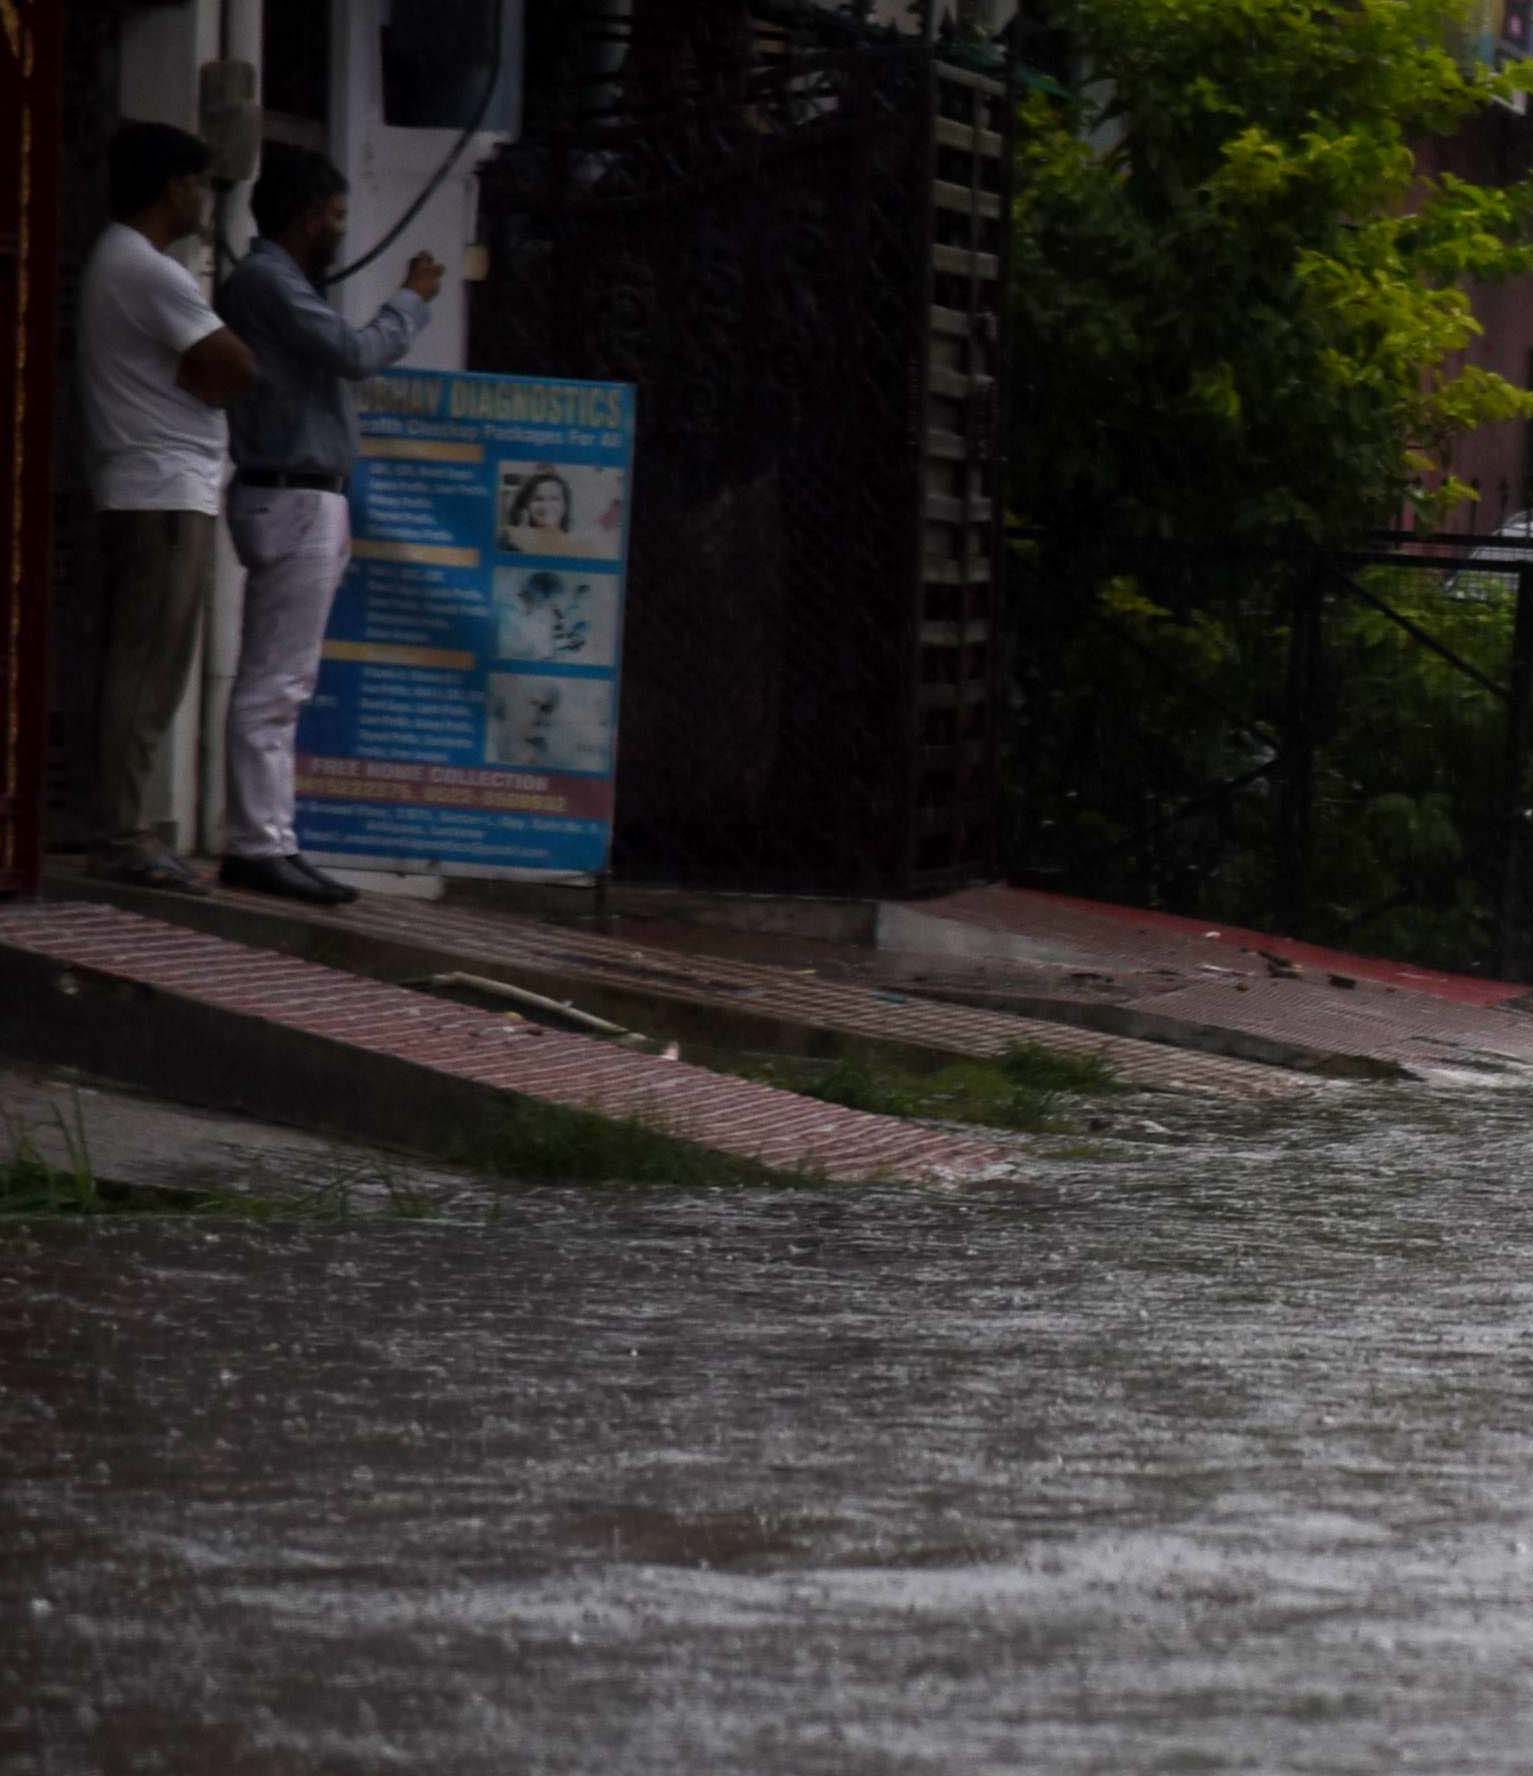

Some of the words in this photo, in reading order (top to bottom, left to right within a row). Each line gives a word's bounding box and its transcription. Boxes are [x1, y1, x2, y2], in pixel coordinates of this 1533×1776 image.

[451, 380, 624, 429] DIAGNOSTICS
[312, 756, 361, 777] FREE
[429, 766, 550, 792] COLLECTION
